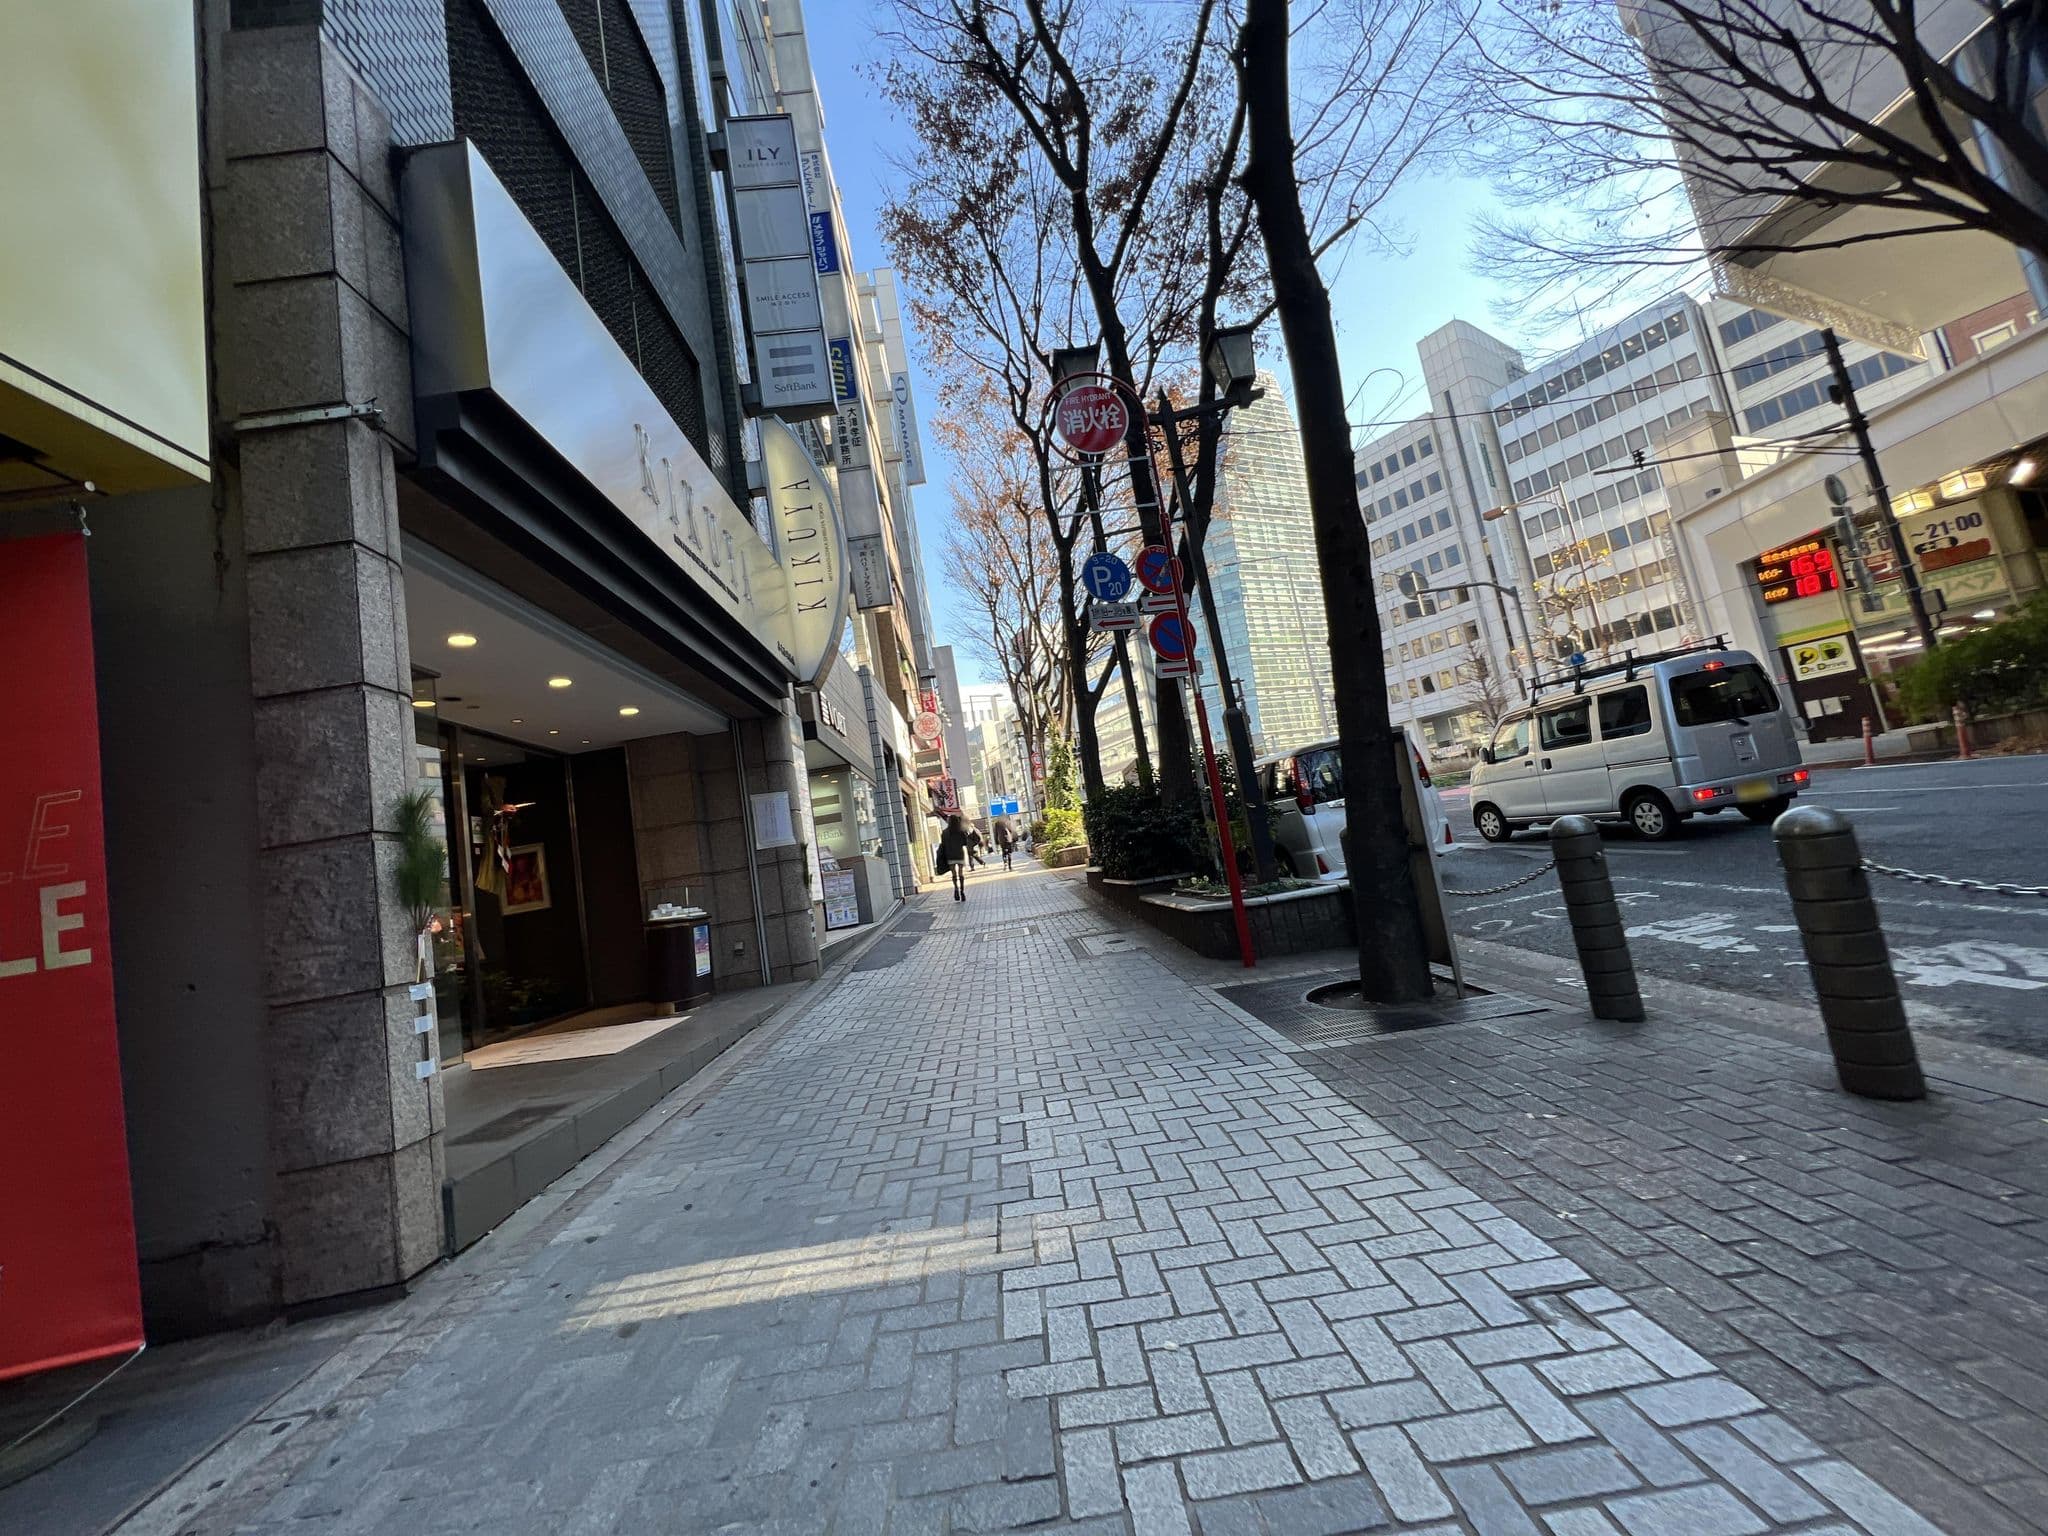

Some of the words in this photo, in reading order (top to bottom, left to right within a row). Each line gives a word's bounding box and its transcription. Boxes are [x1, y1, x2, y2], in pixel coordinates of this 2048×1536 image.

[748, 147, 780, 161] ILY
[756, 294, 778, 303] SMILE
[782, 291, 810, 300] ACCESS
[774, 382, 817, 393] SoftBank
[1065, 396, 1081, 405] FIRE
[1081, 392, 1112, 402] HYDRANT
[1062, 403, 1122, 435] 消火栓
[837, 416, 852, 465] 法律事務所
[780, 478, 828, 613] KIKUYA
[1790, 550, 1832, 577] 169
[1092, 565, 1112, 597] P
[1108, 581, 1123, 596] 20
[1796, 570, 1839, 597] 181
[0, 789, 82, 881] E
